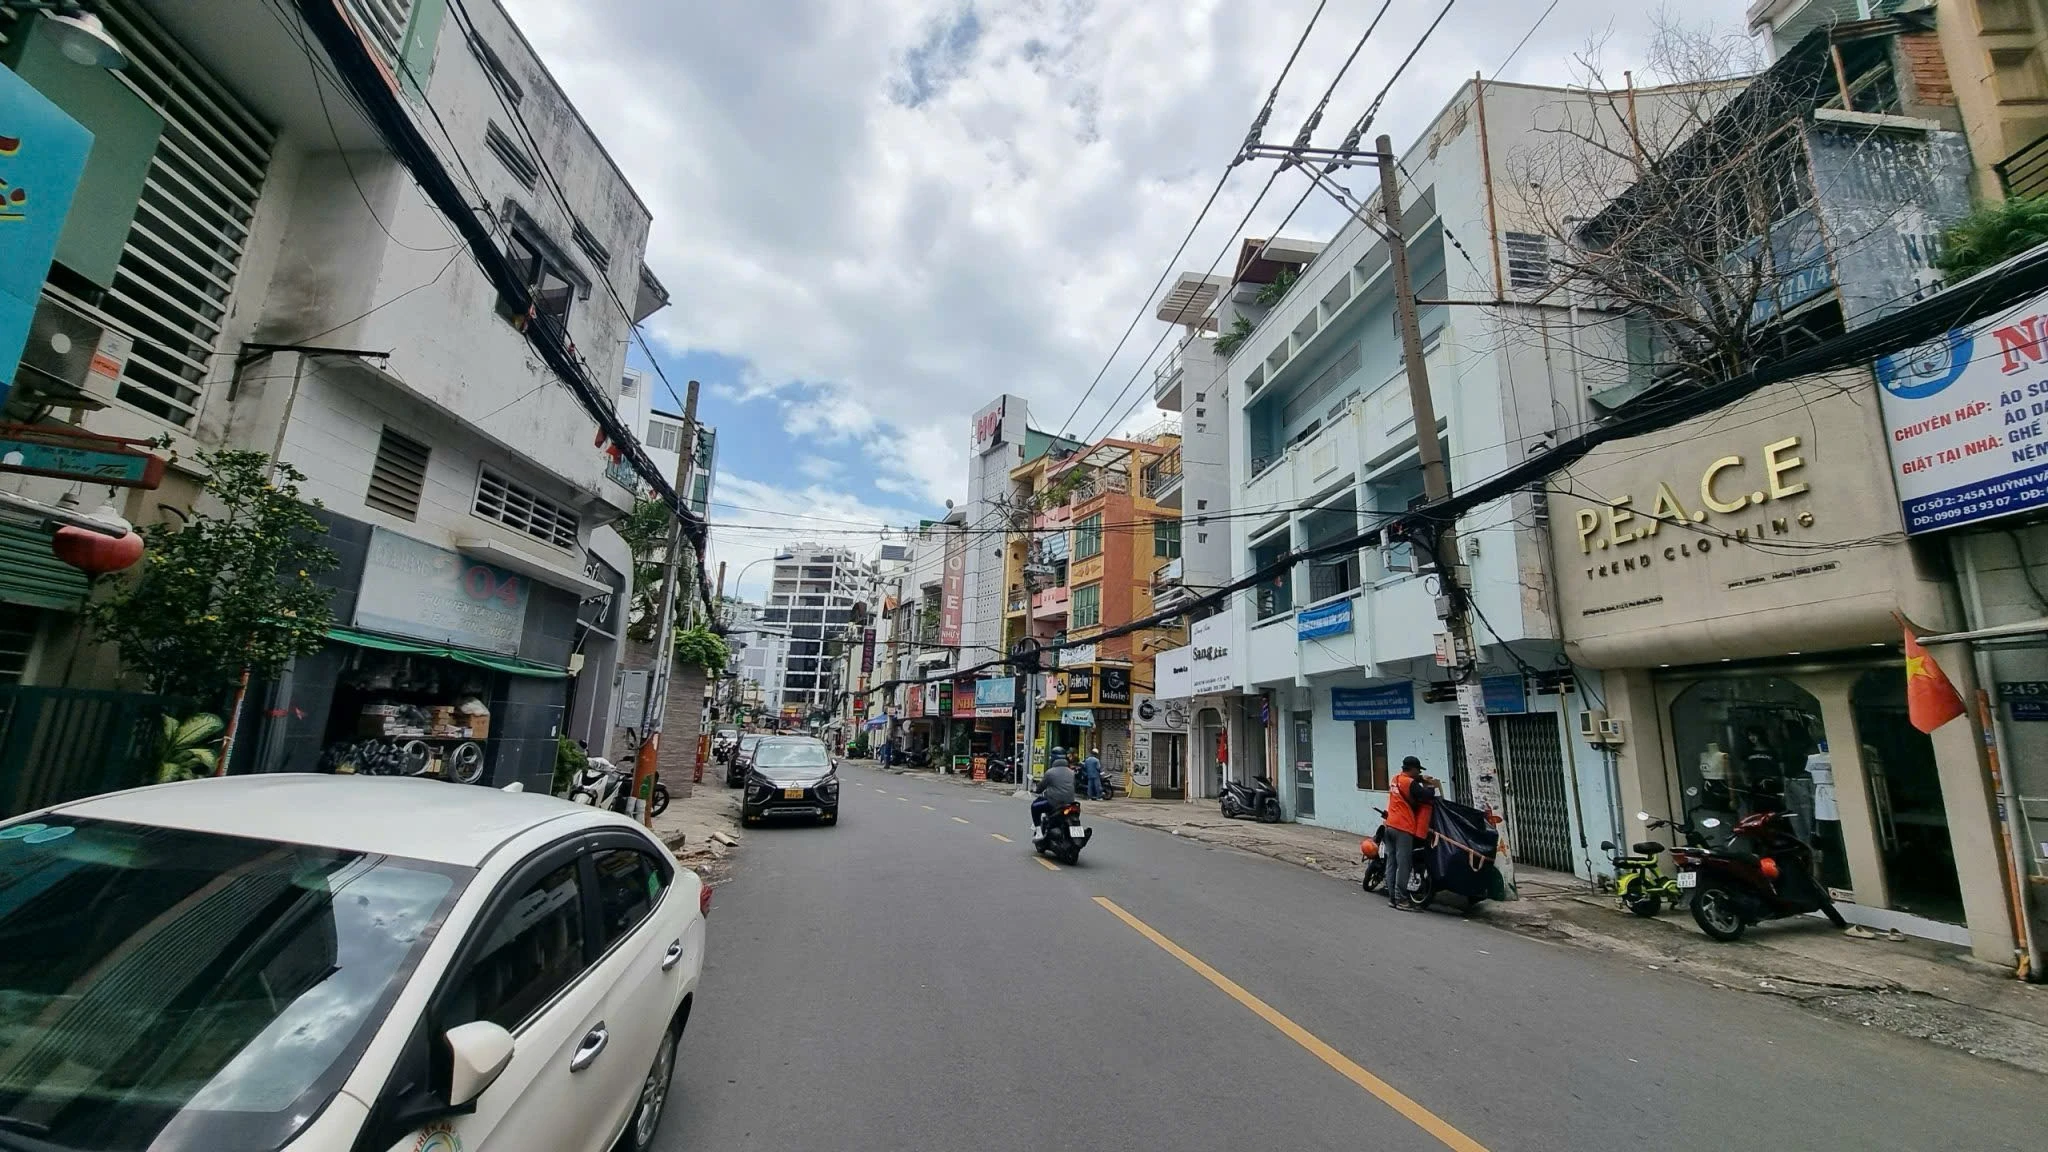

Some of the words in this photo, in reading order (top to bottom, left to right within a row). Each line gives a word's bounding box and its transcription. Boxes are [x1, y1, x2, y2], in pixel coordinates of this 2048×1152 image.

[2000, 388, 2023, 407] ÁO
[2004, 408, 2027, 425] ÁO
[1894, 415, 1952, 443] CHUYÊN
[1955, 400, 1992, 422] HẤP:
[2008, 419, 2043, 443] GHẾ
[1902, 454, 1933, 475] GIẶT
[1937, 447, 1961, 465] TẠI
[1965, 434, 2004, 455] NHÀ:
[1576, 436, 1809, 555] P.E.A.C.E
[1911, 501, 1928, 514] CƠ
[1945, 495, 1957, 506] 2:
[1957, 488, 1987, 503] 245A
[1988, 475, 2034, 496] HUỲNH
[1935, 506, 1962, 521] 0909
[1963, 503, 1978, 515] 83
[1979, 500, 1994, 511] 93
[1995, 495, 2011, 508] 07
[1585, 553, 1651, 582] TREND
[1663, 510, 1815, 562] CLOTHING
